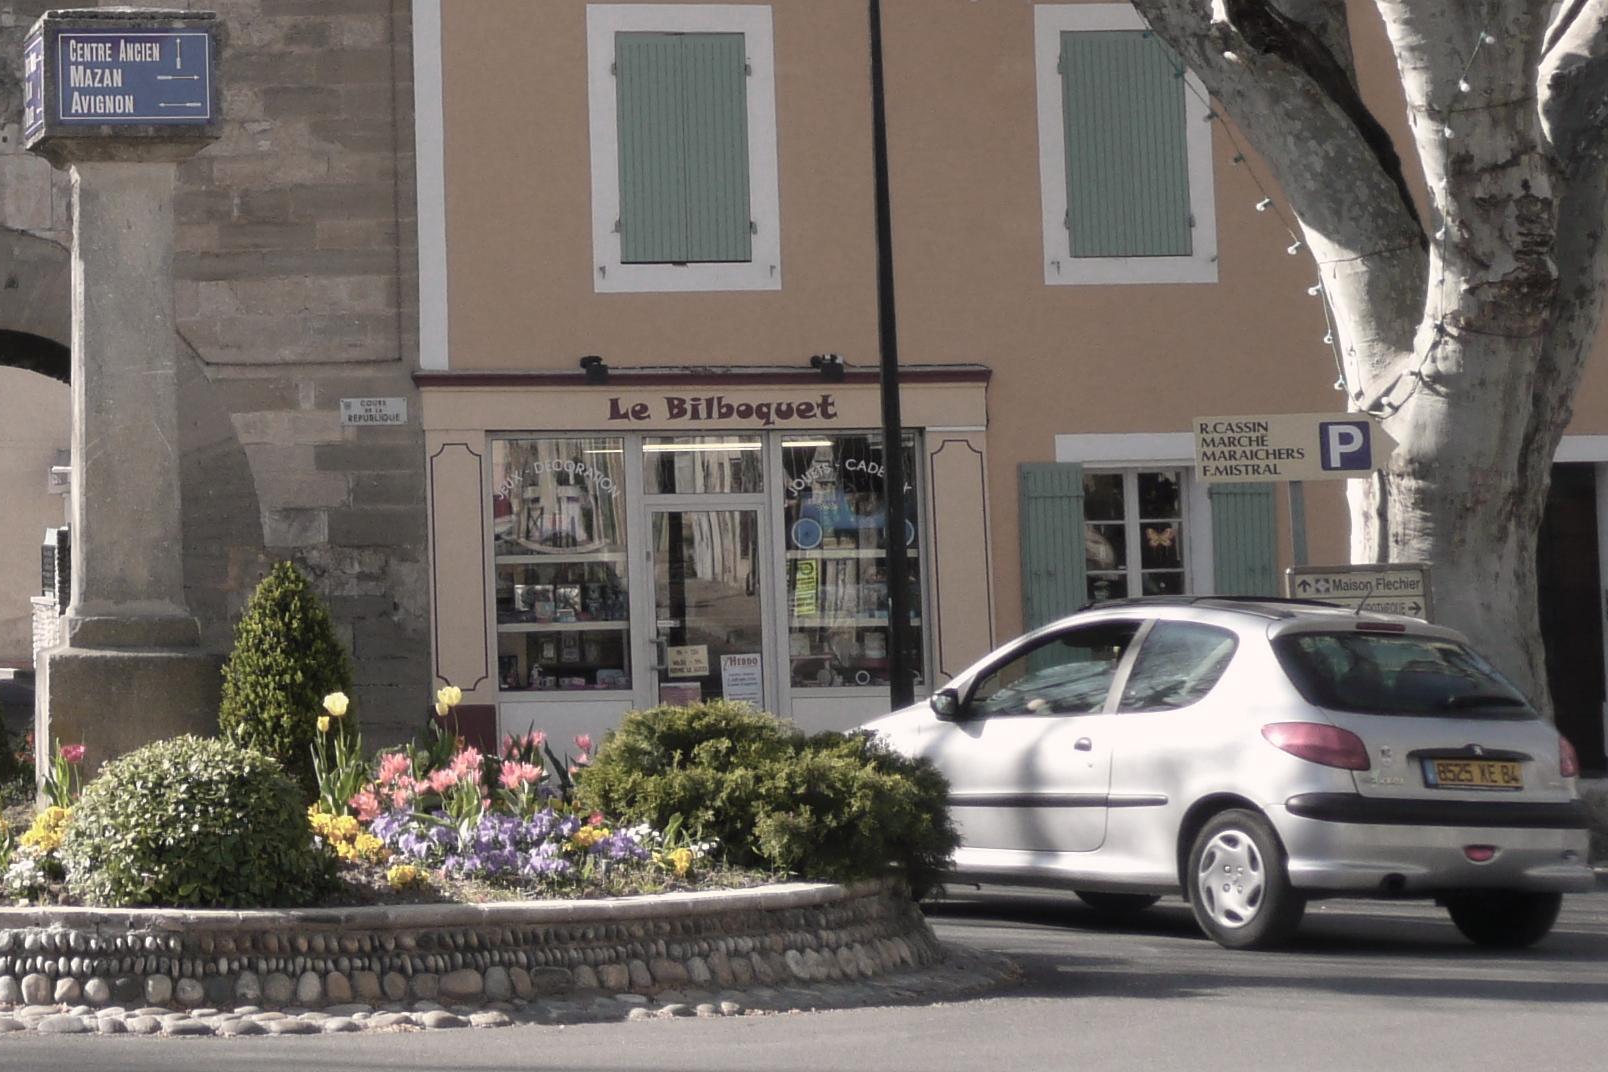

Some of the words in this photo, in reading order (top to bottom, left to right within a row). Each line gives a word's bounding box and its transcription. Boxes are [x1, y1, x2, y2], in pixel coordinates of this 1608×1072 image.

[69, 39, 112, 62] CENTRE
[119, 39, 160, 62] ANCIEN
[70, 65, 122, 88] MAZAN
[71, 91, 134, 114] AVIGNON
[607, 397, 651, 421] Le
[663, 394, 839, 426] Bilboquet
[1199, 421, 1269, 435] R.CASSIN
[1201, 448, 1305, 461] MARAICHERS
[1328, 424, 1364, 468] P
[788, 462, 831, 497] JOUETS
[1202, 464, 1281, 477] F.MISTRAL
[495, 469, 523, 500] JEUX
[1332, 579, 1372, 592] Maison
